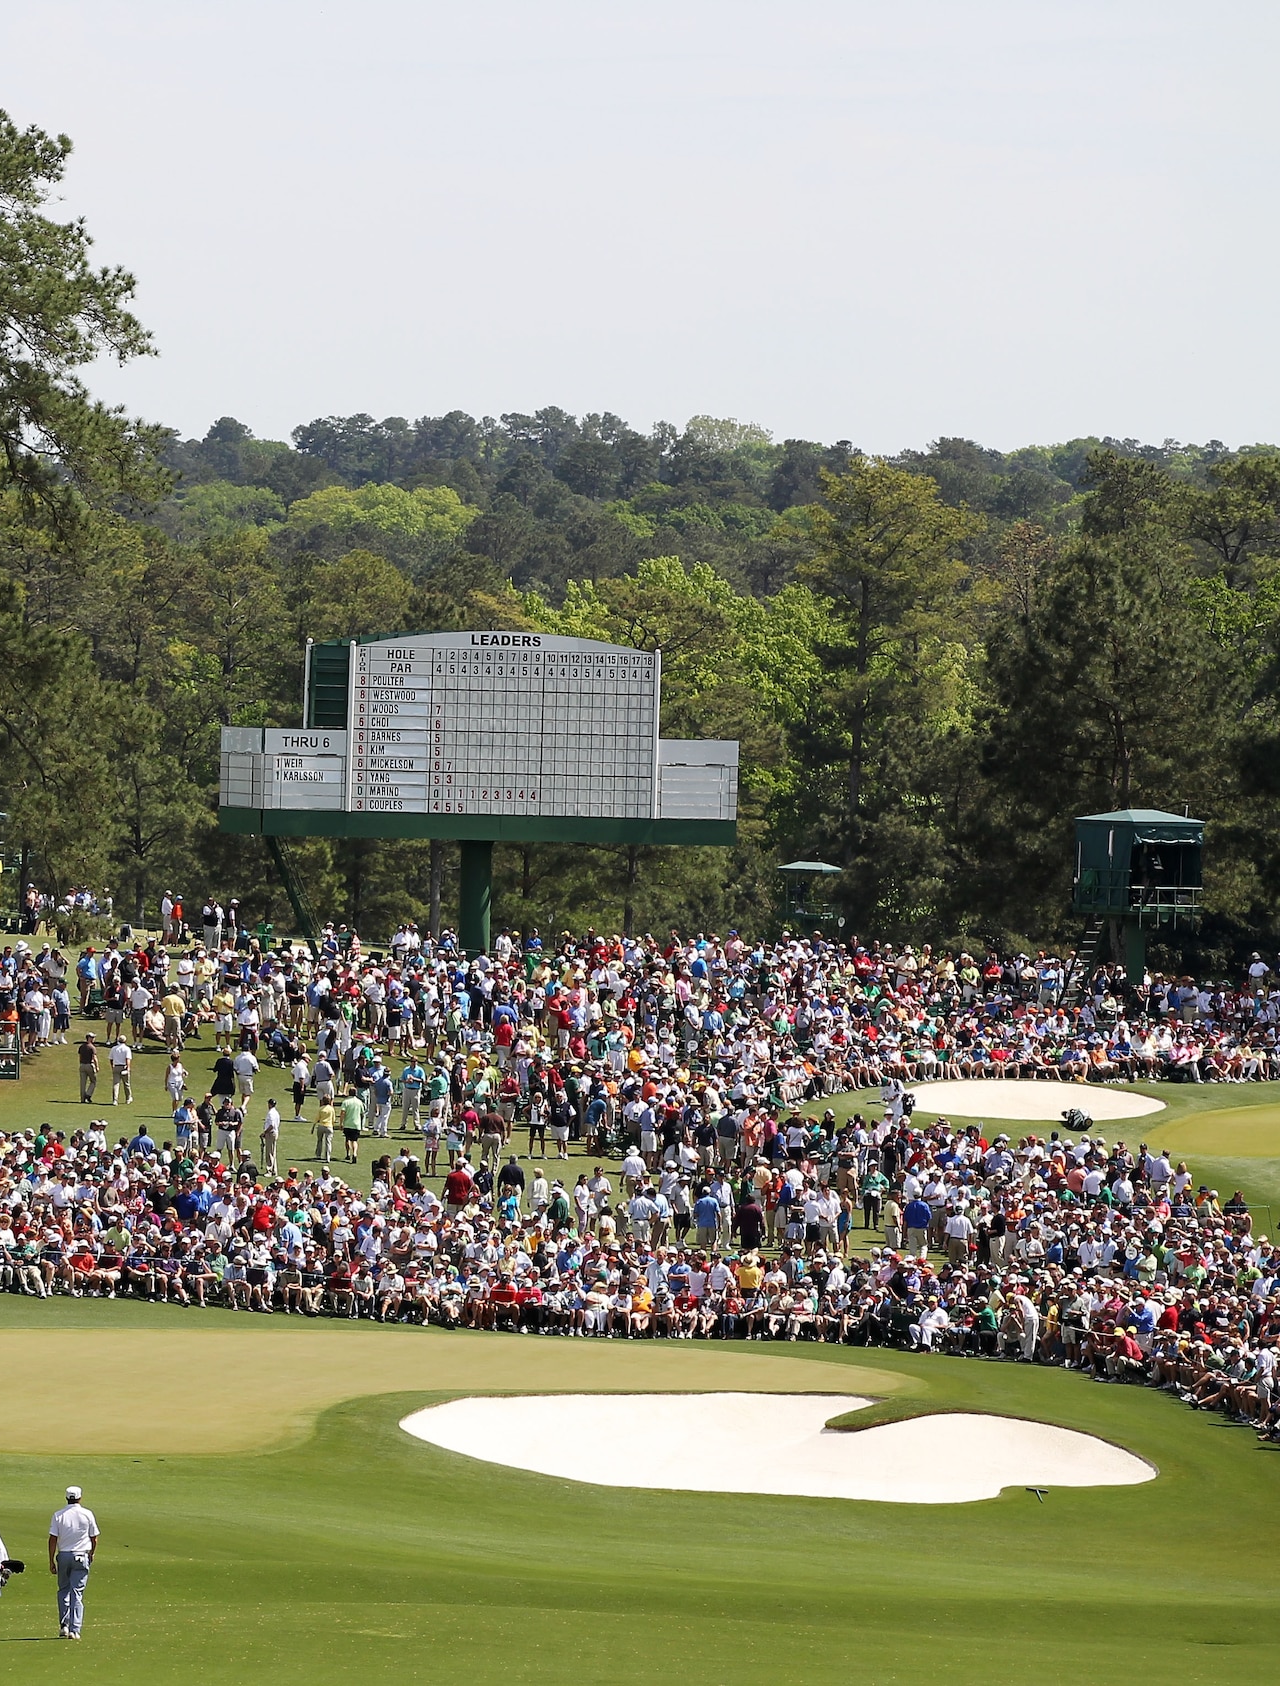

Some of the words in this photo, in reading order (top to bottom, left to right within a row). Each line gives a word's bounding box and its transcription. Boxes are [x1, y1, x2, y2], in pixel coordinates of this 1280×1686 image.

[472, 634, 542, 646] LEADERS
[388, 650, 415, 660] HOLE
[498, 653, 503, 661] 6
[596, 656, 604, 664] 14
[608, 656, 616, 664] 15
[620, 656, 628, 664] 16
[632, 656, 640, 665] 17
[644, 657, 652, 665] 18
[390, 663, 412, 672] PAR
[436, 665, 441, 673] 4
[450, 665, 455, 674] 5
[461, 665, 466, 674] 4
[474, 665, 478, 674] 3
[486, 665, 491, 674] 4
[497, 666, 503, 675] 3
[510, 667, 515, 675] 4
[522, 667, 527, 676] 5
[534, 667, 539, 676] 4
[548, 668, 553, 676] 4
[560, 668, 565, 677] 4
[573, 668, 577, 677] 3
[585, 668, 590, 678] 5
[596, 669, 601, 678] 4
[610, 669, 614, 678] 5
[621, 670, 626, 678] 3
[632, 670, 637, 678] 4
[645, 670, 650, 679] 4
[361, 676, 365, 685] 8
[373, 676, 404, 686] POULTER
[360, 691, 365, 699] 8
[373, 690, 416, 700] WESTWOOD
[360, 704, 364, 712] 6
[372, 704, 398, 714] WOODS
[436, 706, 441, 714] 7
[372, 718, 388, 727] CHOI
[436, 720, 440, 728] 6
[282, 736, 318, 747] THRU
[323, 738, 330, 747] 6
[359, 732, 364, 740] 6
[372, 732, 400, 741] BARNES
[435, 734, 440, 742] 5
[358, 745, 363, 754] 6
[371, 745, 384, 754] KIM
[435, 747, 440, 756] 5
[277, 759, 280, 767] 1
[284, 758, 302, 768] WEIR
[371, 760, 414, 769] MICKELSON
[435, 762, 440, 770] 6
[447, 762, 451, 770] 7
[284, 772, 323, 781] KARLSSON
[358, 773, 362, 781] 5
[371, 773, 390, 782] YANG
[435, 776, 440, 784] 5
[447, 775, 451, 784] 3
[370, 787, 399, 796] MARINO
[460, 790, 462, 798] 1
[482, 790, 487, 799] 2
[495, 791, 499, 799] 3
[507, 790, 511, 799] 3
[519, 791, 524, 799] 4
[531, 791, 535, 800] 4
[357, 800, 362, 809] 3
[370, 801, 402, 810] COUPLES
[434, 802, 438, 811] 4
[446, 803, 450, 812] 5
[458, 803, 463, 812] 5
